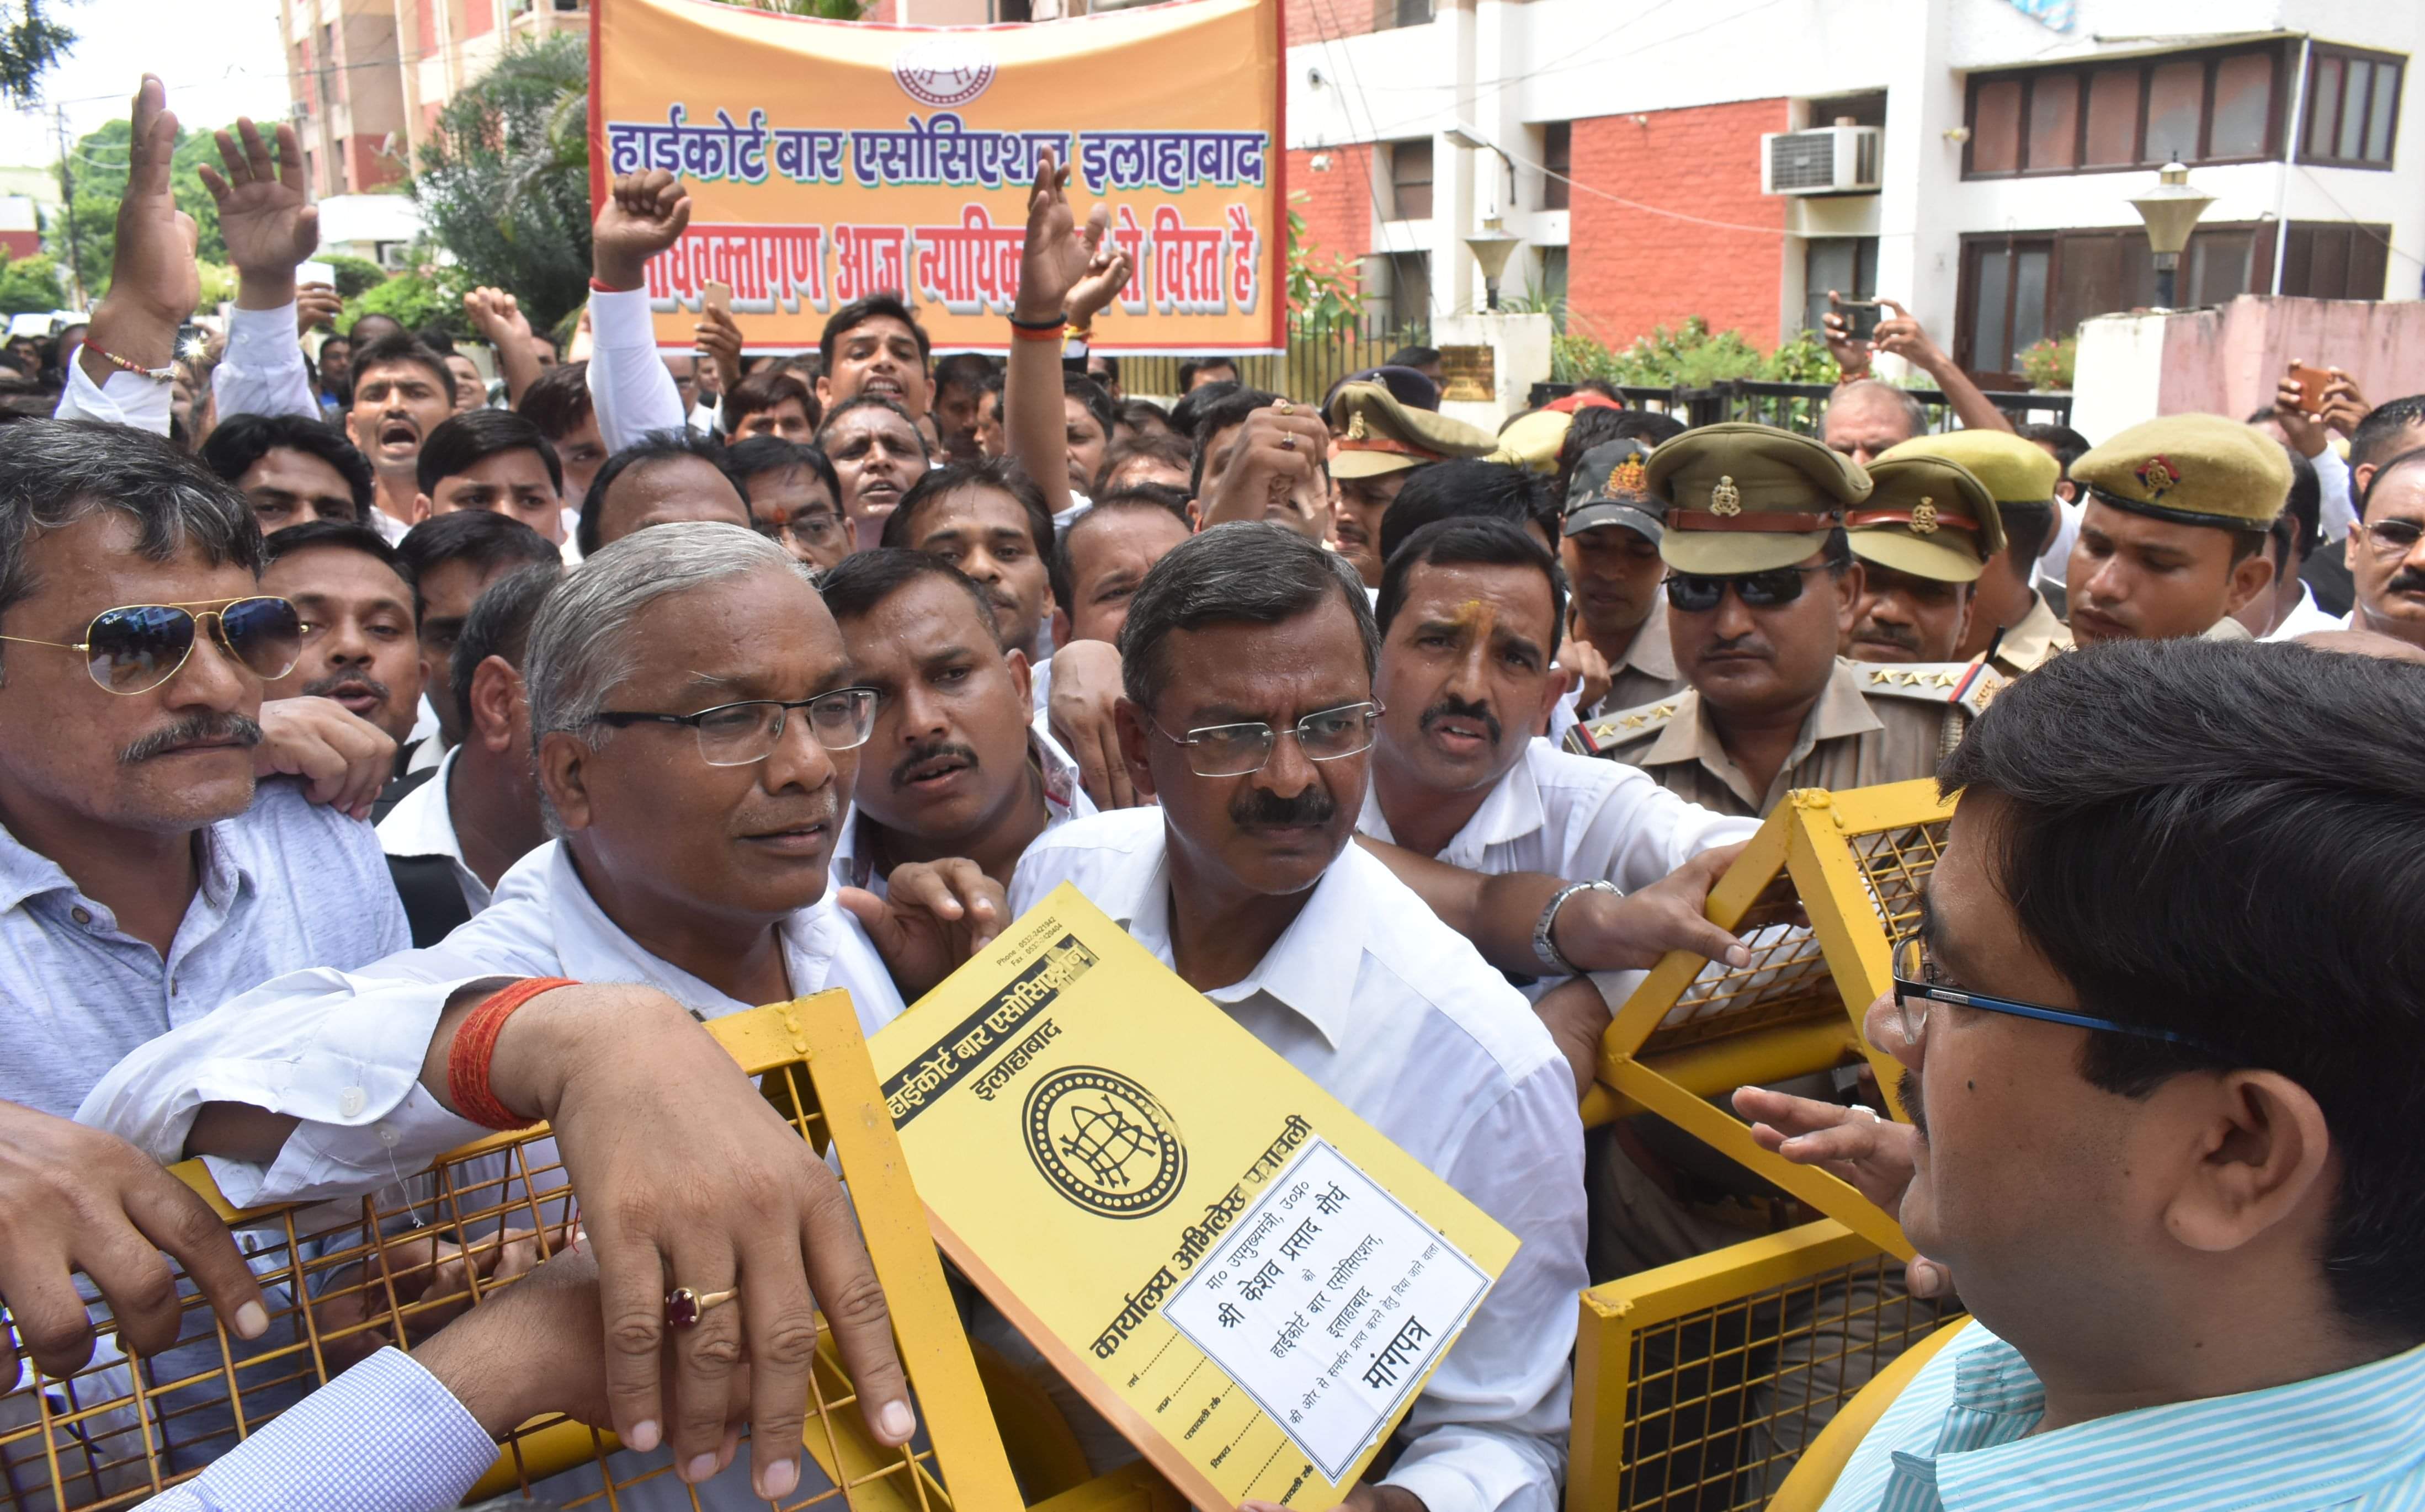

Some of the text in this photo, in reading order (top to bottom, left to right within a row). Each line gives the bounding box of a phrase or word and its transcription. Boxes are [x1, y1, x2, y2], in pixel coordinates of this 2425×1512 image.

[608, 104, 765, 182] हाईकोर्ट
[774, 130, 843, 179] बार
[1080, 133, 1265, 189] इलाहाबाद
[834, 226, 905, 301] आज
[1153, 206, 1222, 301] विरत
[1229, 206, 1253, 301] है
[996, 950, 1017, 966] Phone
[1011, 956, 1023, 967] Fax
[886, 1046, 959, 1120] हाईकोर्ट
[951, 1025, 993, 1060] बार
[969, 1018, 1062, 1101] इलाहाबाद
[1089, 1265, 1178, 1359] कार्यालय
[1172, 1183, 1251, 1270] अभिलेख
[1218, 1180, 1350, 1328] श्री केशव प्रसाद मौर्य
[1301, 1268, 1316, 1281] को
[1270, 1311, 1309, 1359] हाईकोर्ट
[1306, 1291, 1331, 1314] बार
[1289, 1243, 1440, 1424] की ओर से समर्थन प्राप्त करने हेतु दिया जाने वाला
[1326, 1286, 1373, 1338] इलाहाबाद
[1362, 1315, 1432, 1388] मांगपत्र
[1210, 1445, 1231, 1469] विषय
